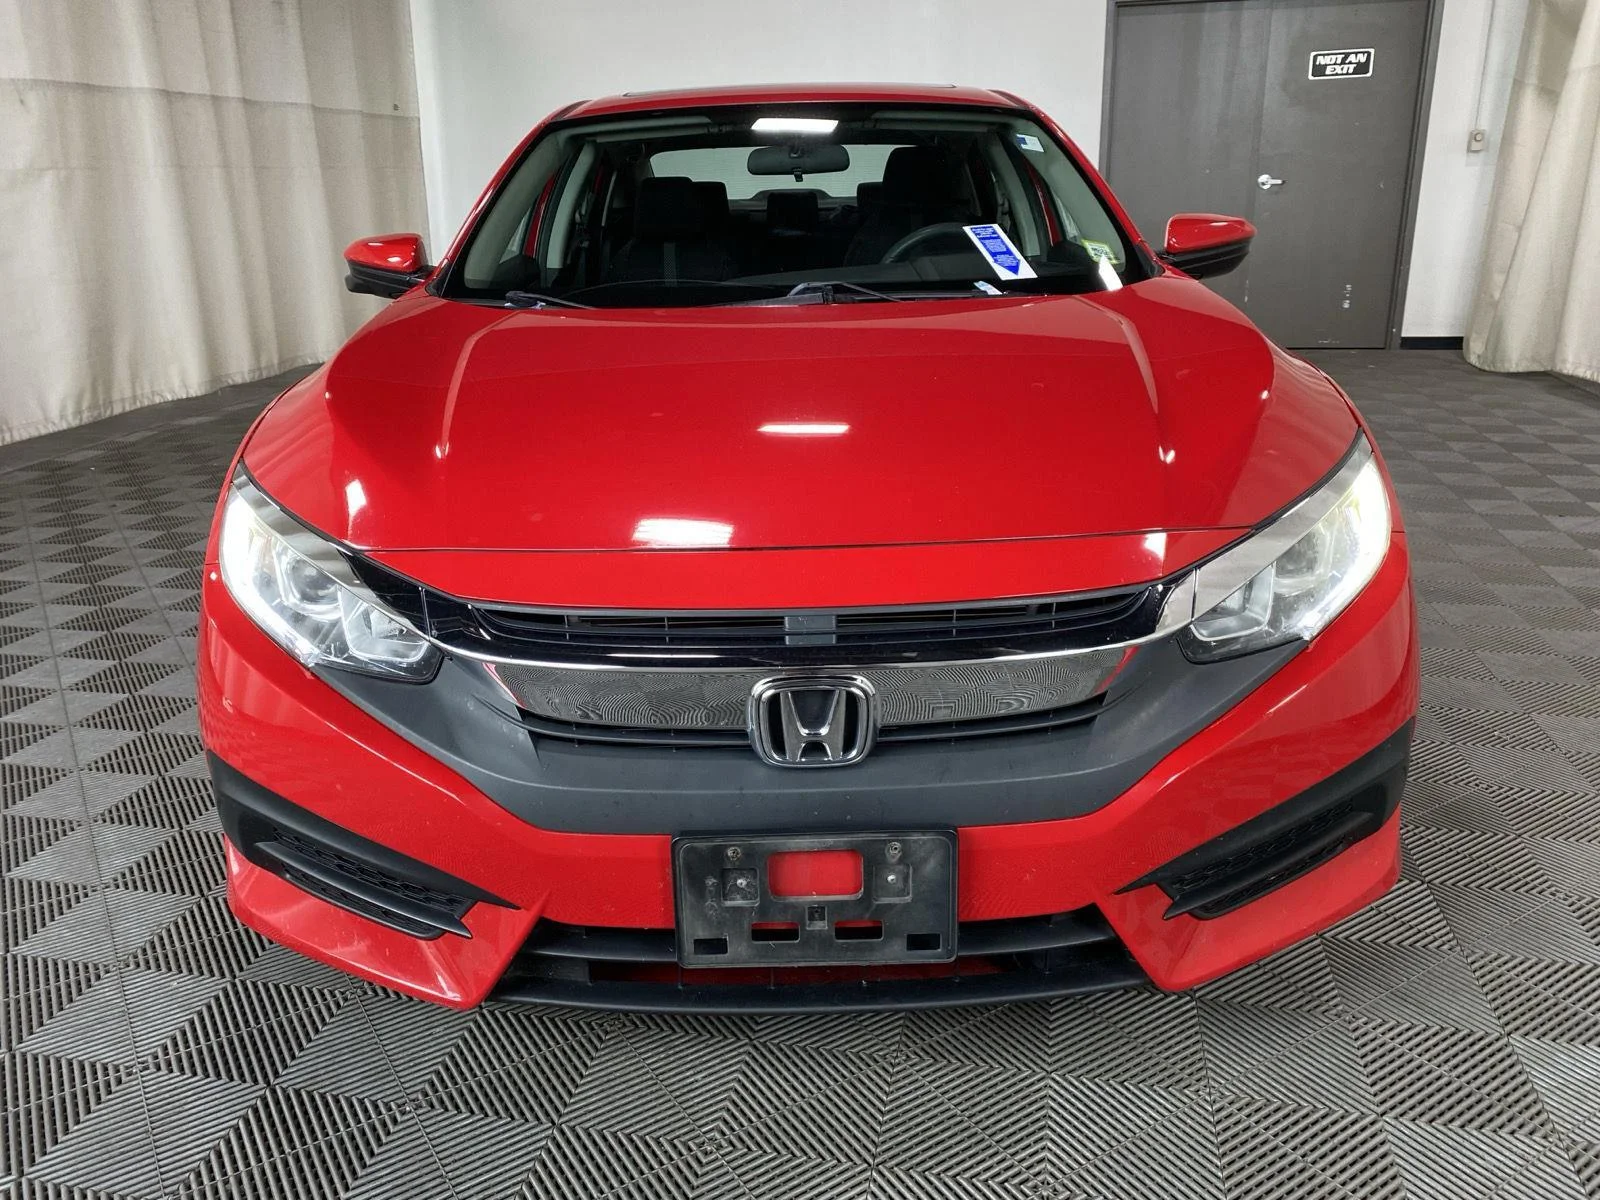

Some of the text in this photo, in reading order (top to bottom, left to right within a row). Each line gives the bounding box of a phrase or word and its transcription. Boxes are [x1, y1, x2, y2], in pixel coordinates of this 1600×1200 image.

[1316, 53, 1368, 65] NOT AN
[1325, 64, 1357, 75] EXIT
